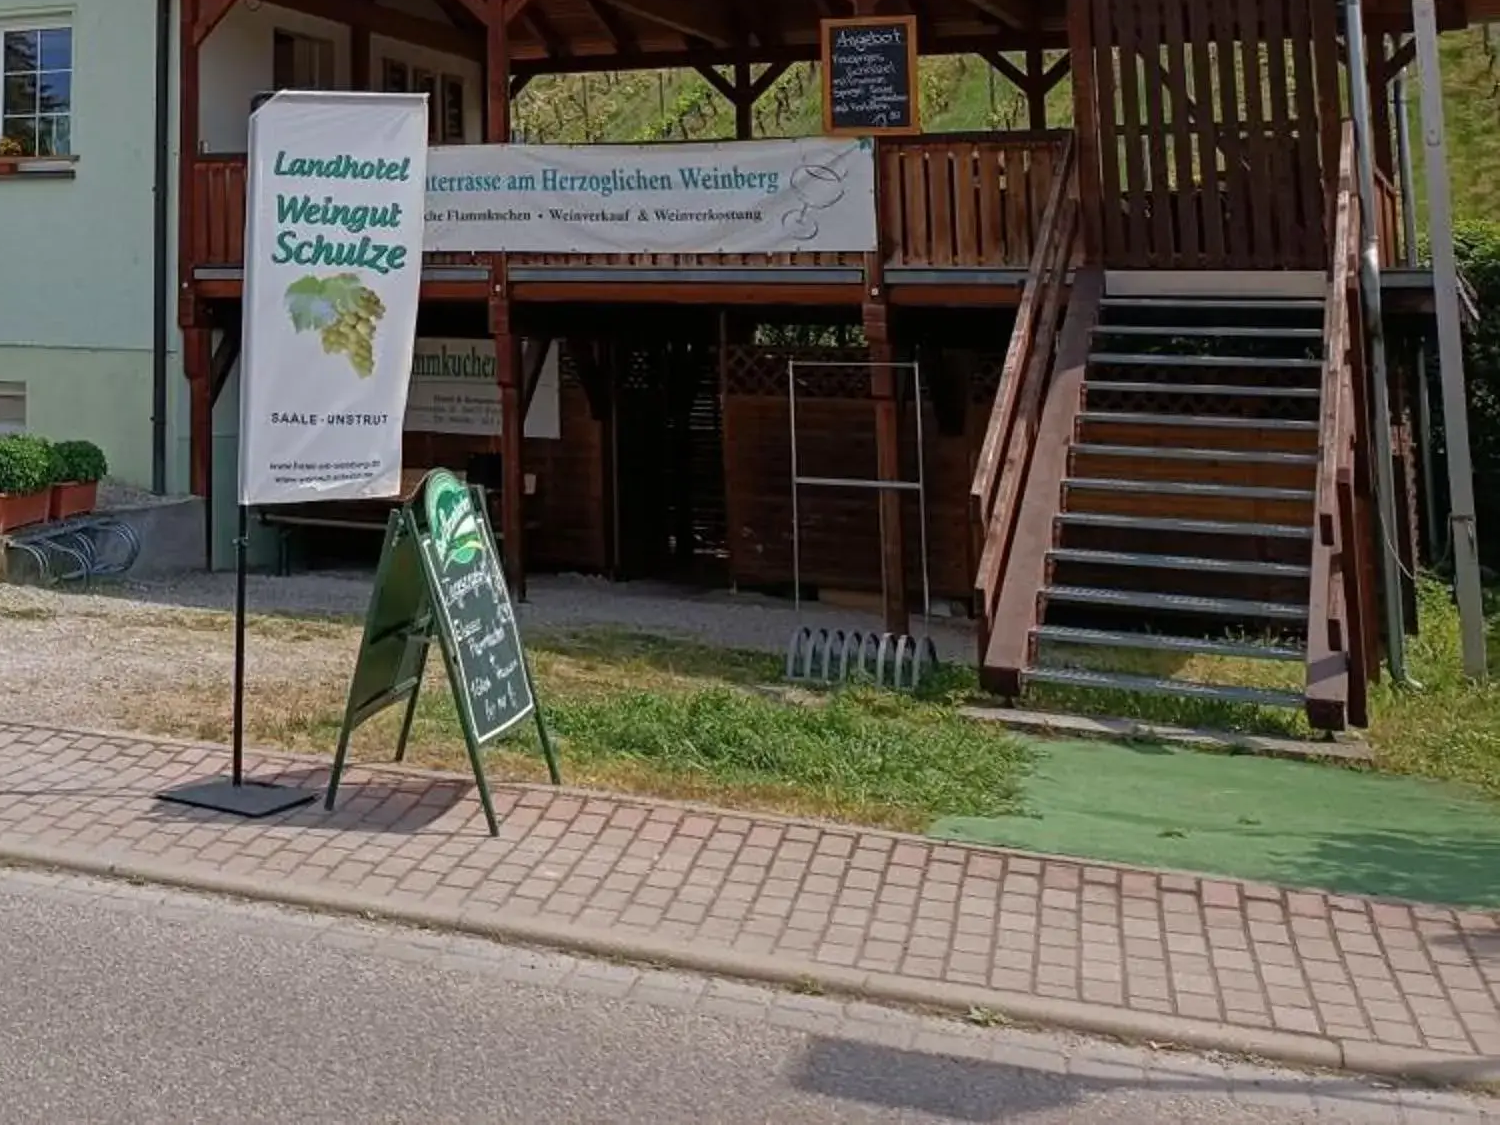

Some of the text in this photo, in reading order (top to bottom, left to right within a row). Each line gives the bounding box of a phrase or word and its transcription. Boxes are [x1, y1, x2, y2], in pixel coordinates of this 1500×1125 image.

[274, 151, 410, 181] Landhotel
[507, 174, 536, 192] am
[542, 168, 672, 196] Herzoglichen
[678, 165, 780, 194] Weinberg
[277, 193, 402, 233] Weingut
[447, 208, 531, 222] Flammkuchen
[549, 209, 629, 222] Weinverkauf
[637, 209, 649, 222] &
[654, 208, 763, 223] Weinverkostung
[272, 230, 406, 274] Schulze
[271, 412, 317, 426] SAALE
[327, 413, 389, 426] UNSTRUT
